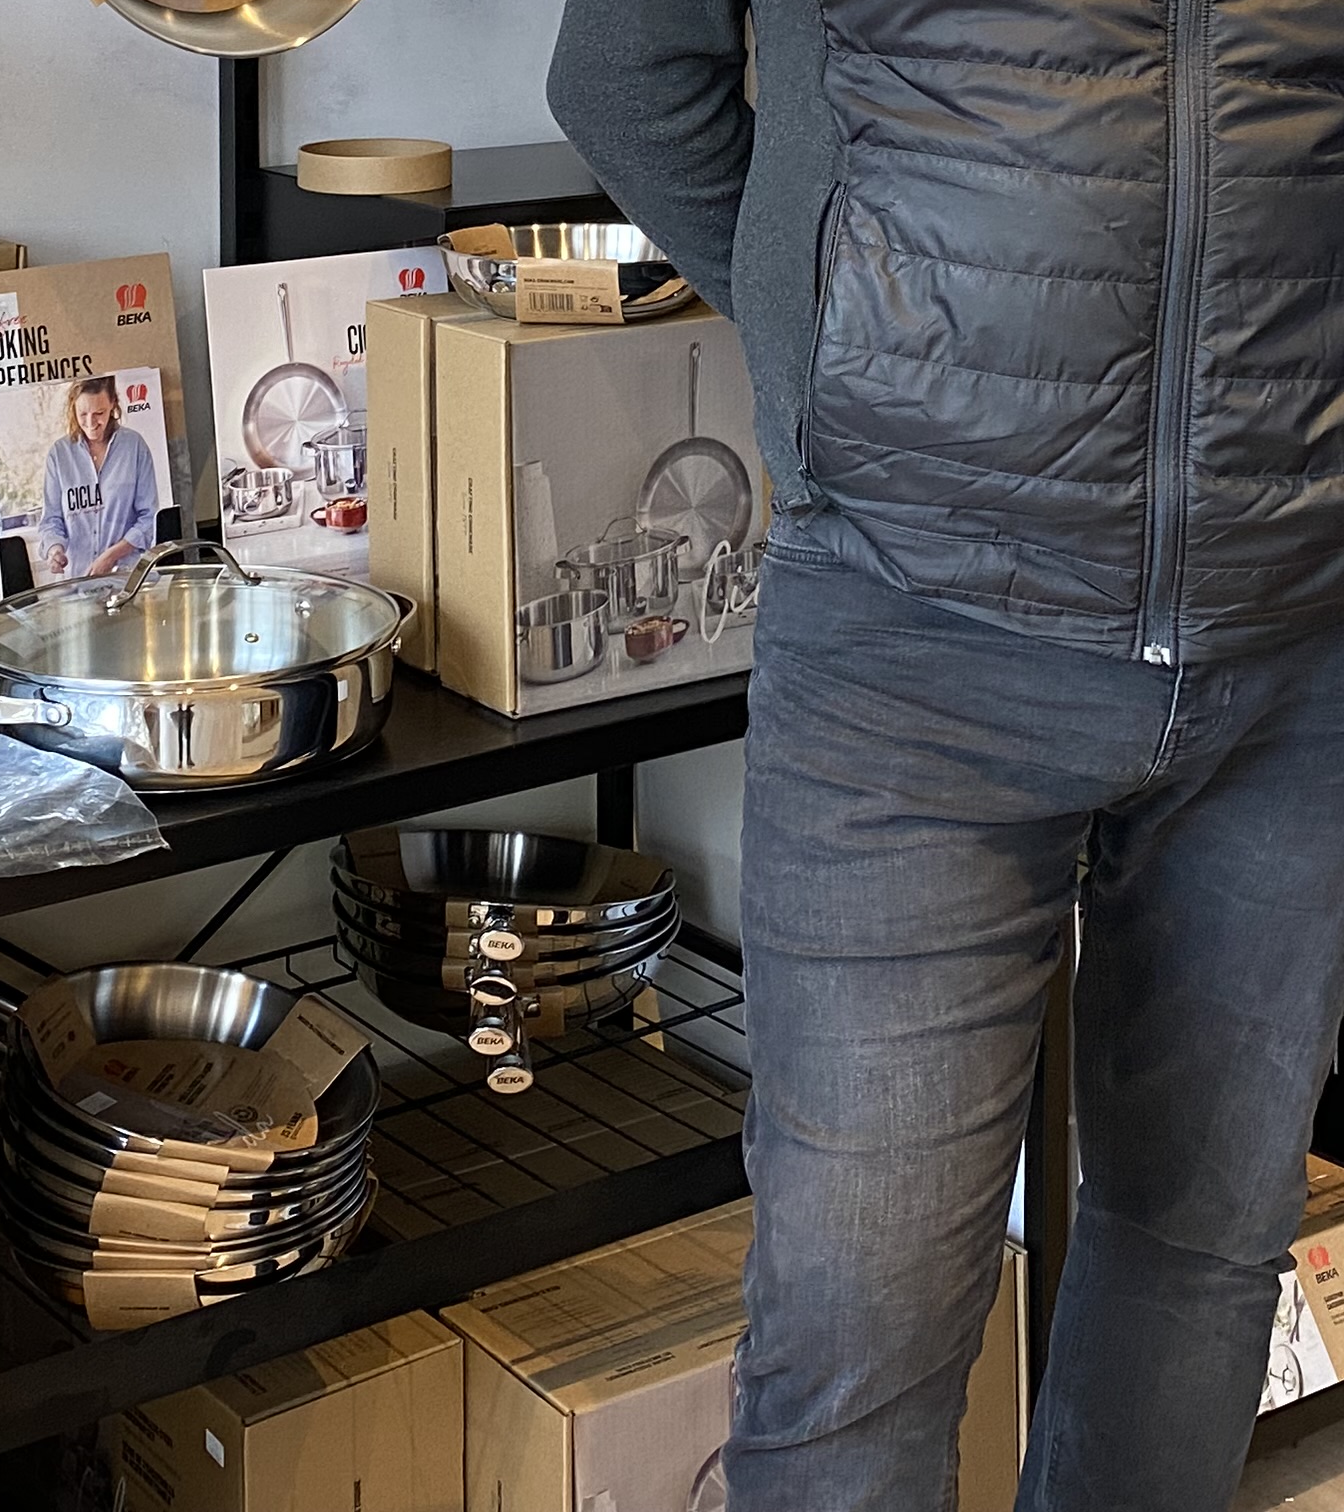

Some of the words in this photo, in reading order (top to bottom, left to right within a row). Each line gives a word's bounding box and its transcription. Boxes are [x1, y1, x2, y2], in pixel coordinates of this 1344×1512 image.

[117, 311, 152, 327] BEKA
[126, 402, 151, 414] BEKA
[68, 484, 103, 511] CICLA
[488, 940, 516, 950] BEKA
[476, 1037, 504, 1046] BEKA
[496, 1076, 524, 1084] BEKA
[1315, 1268, 1340, 1285] BEKA
